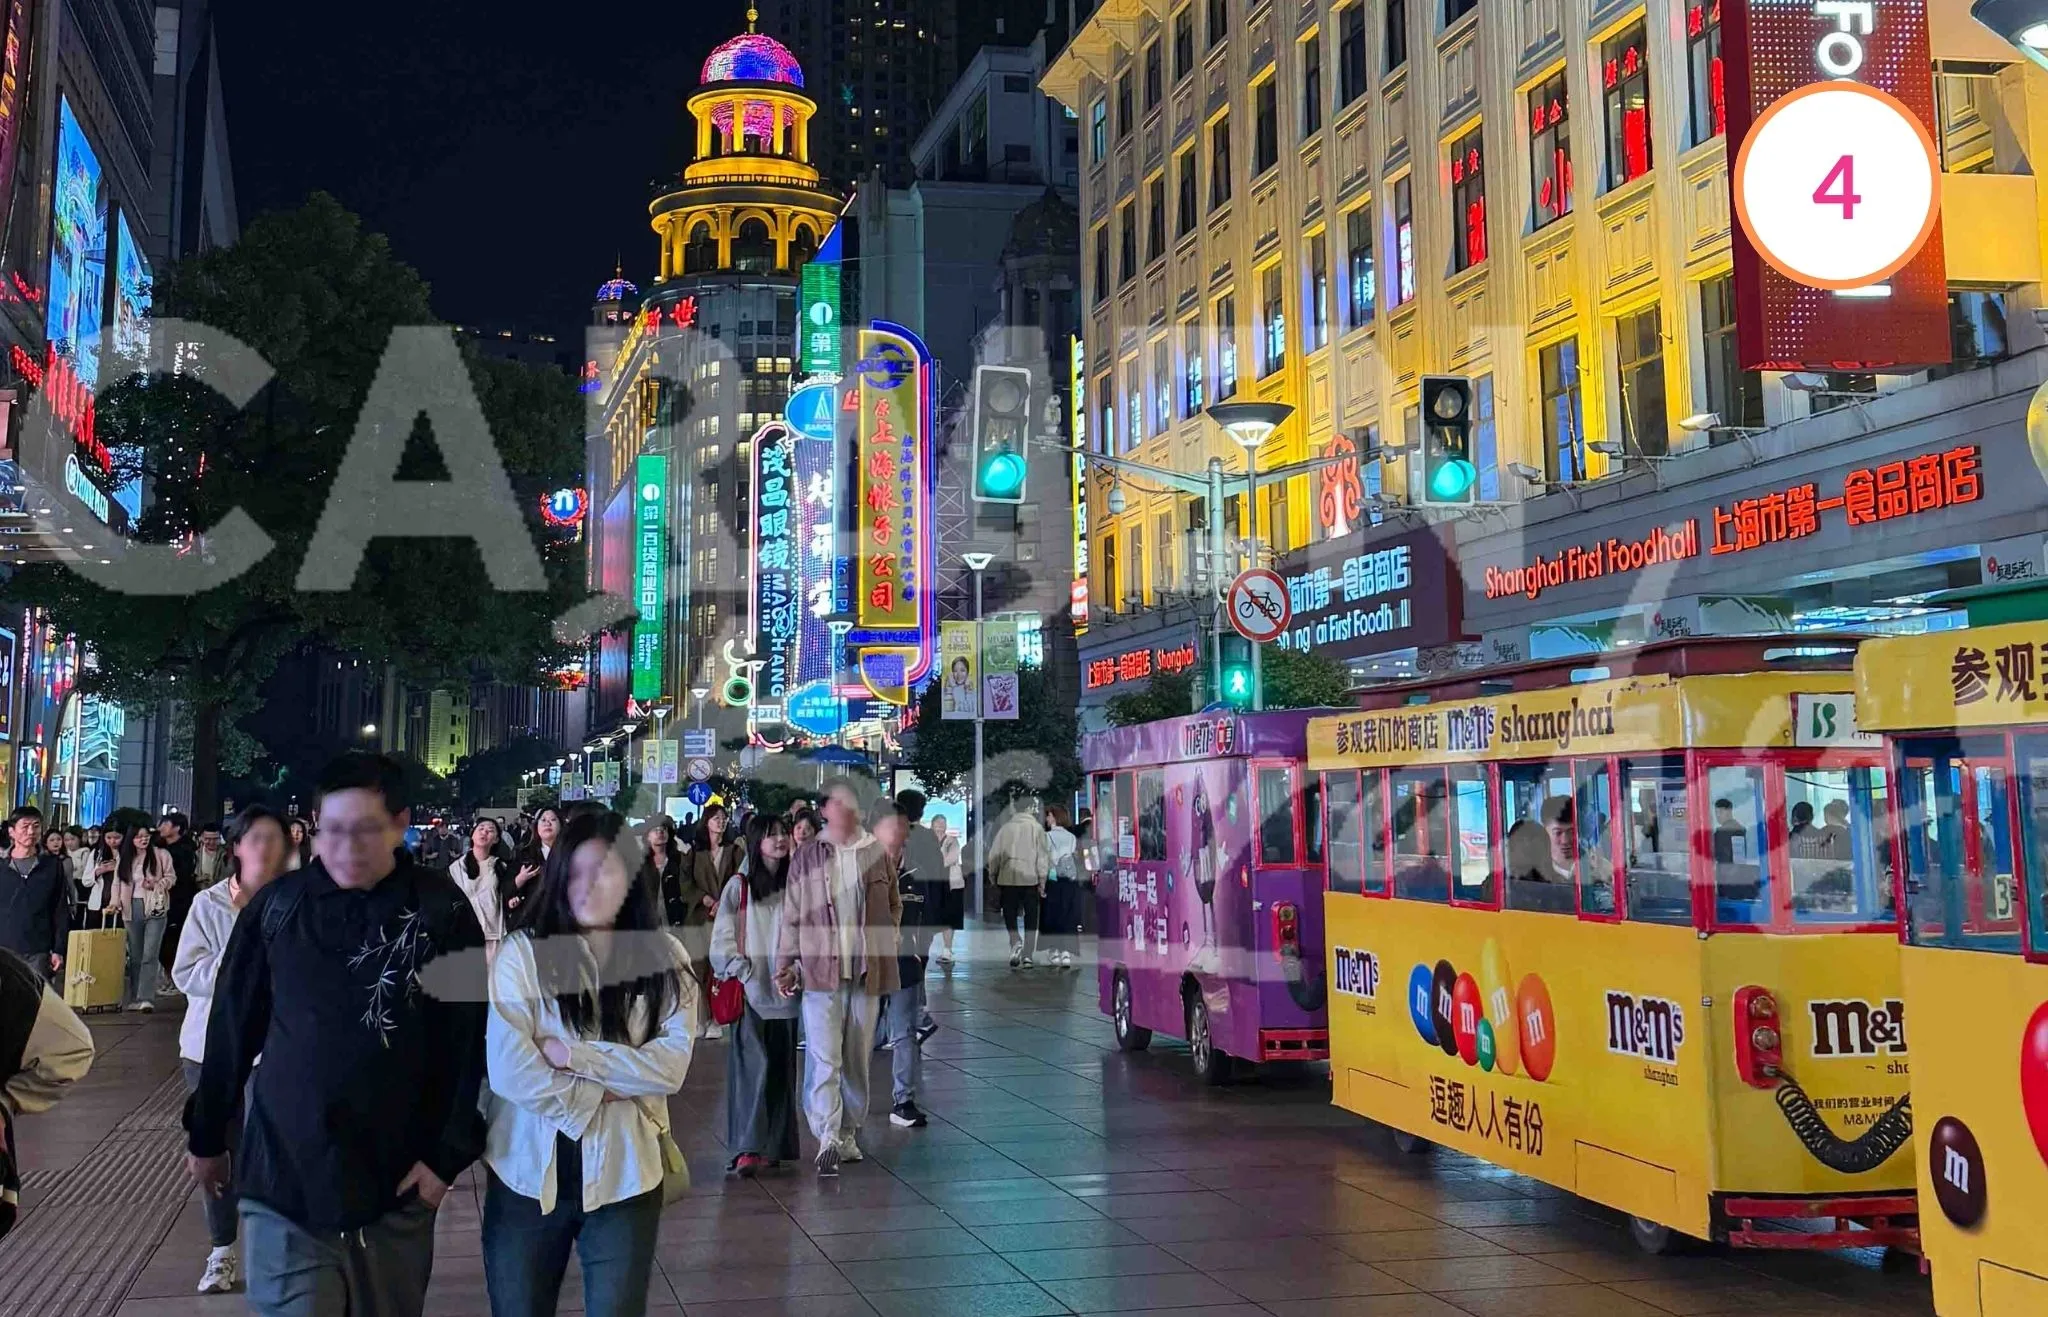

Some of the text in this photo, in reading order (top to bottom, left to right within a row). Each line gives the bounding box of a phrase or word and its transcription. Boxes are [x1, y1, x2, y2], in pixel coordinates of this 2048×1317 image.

[758, 445, 791, 569] 茂昌眼镜
[1710, 445, 1985, 556] 上海市第一食品商店
[1485, 519, 1696, 600] Shanghai First Foodhall
[1157, 640, 1195, 675] Shanghai
[1951, 646, 2048, 706] 参观
[1336, 711, 1438, 755] 参观我们的商店
[1501, 689, 1615, 750] shanghai
[1429, 1074, 1544, 1157] 逗趣人人有份
